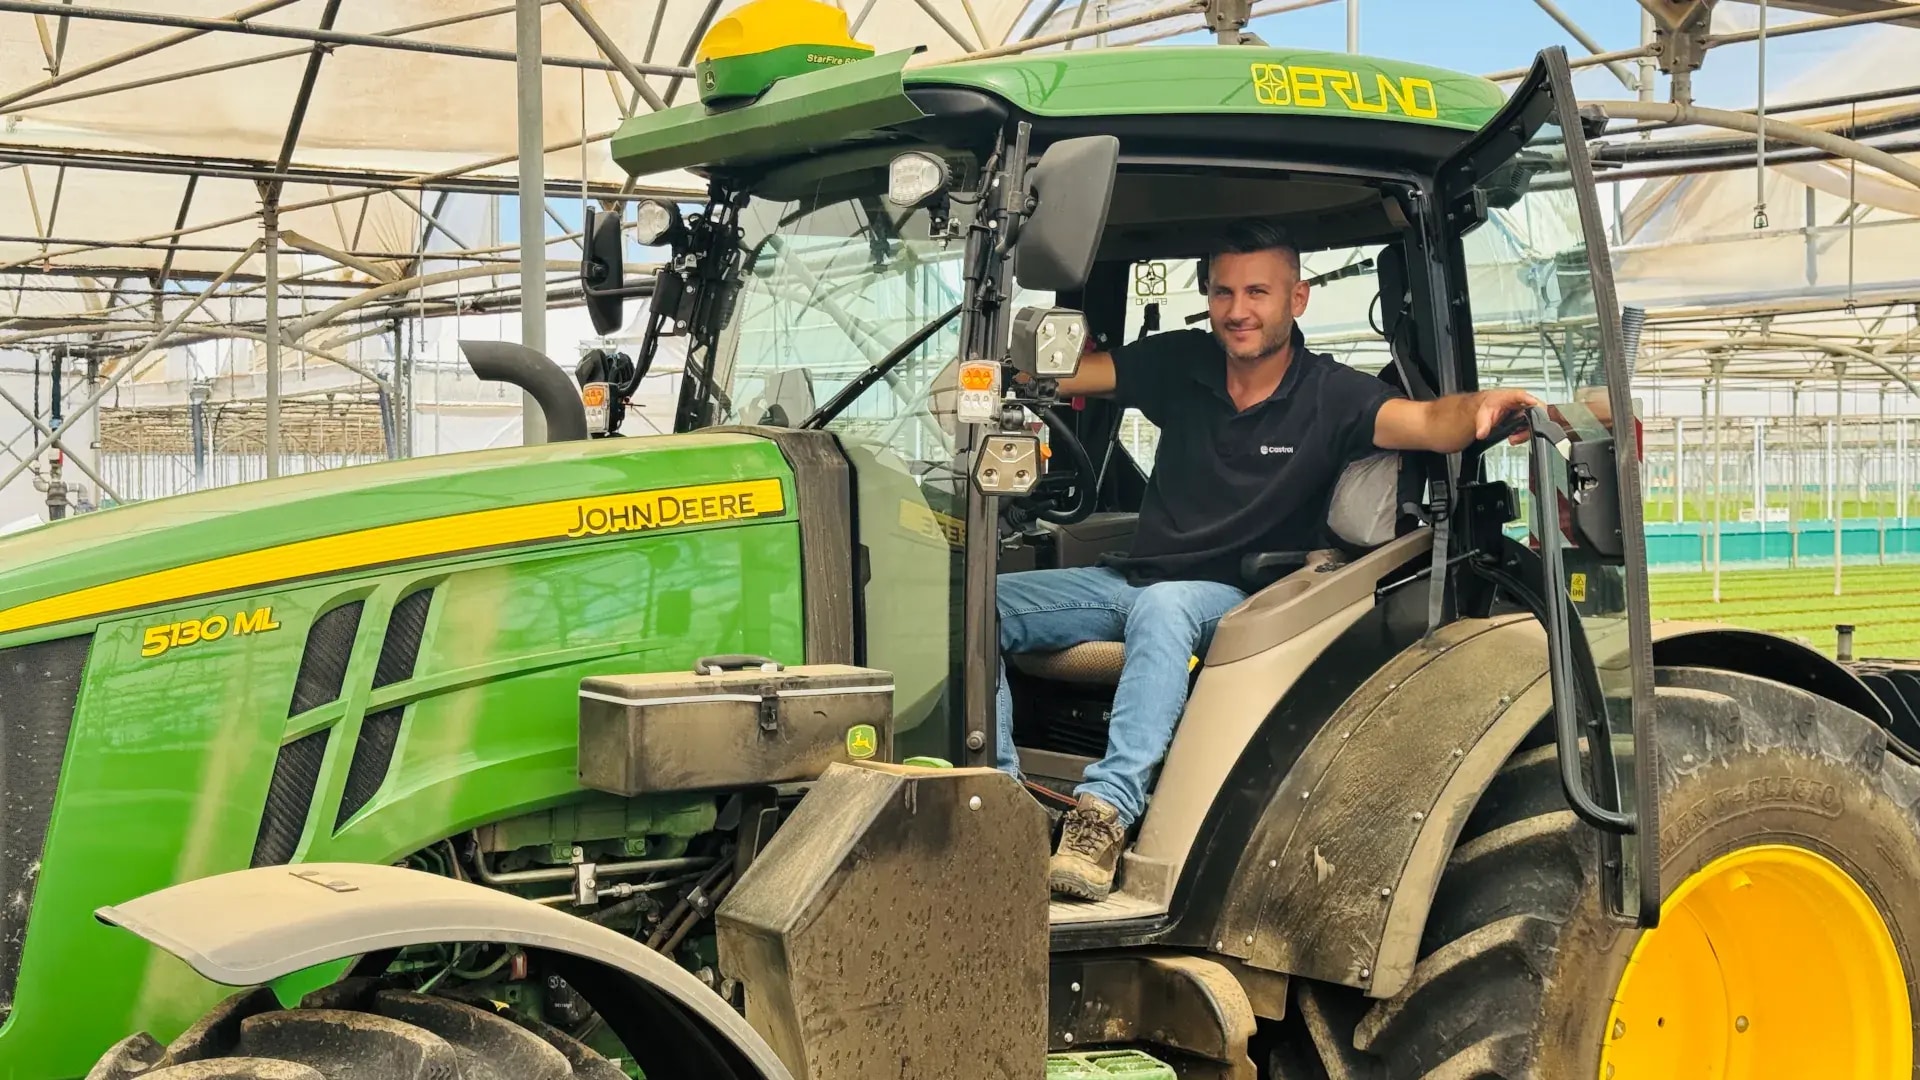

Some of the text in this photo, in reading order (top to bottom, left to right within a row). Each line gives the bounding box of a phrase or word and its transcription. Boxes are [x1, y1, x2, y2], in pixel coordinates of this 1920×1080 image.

[806, 53, 843, 65] StarFire
[1288, 66, 1438, 119] BRUNO
[1268, 446, 1294, 454] Castrol
[568, 492, 755, 534] JOHN DEERE
[141, 606, 282, 657] 5130 ML
